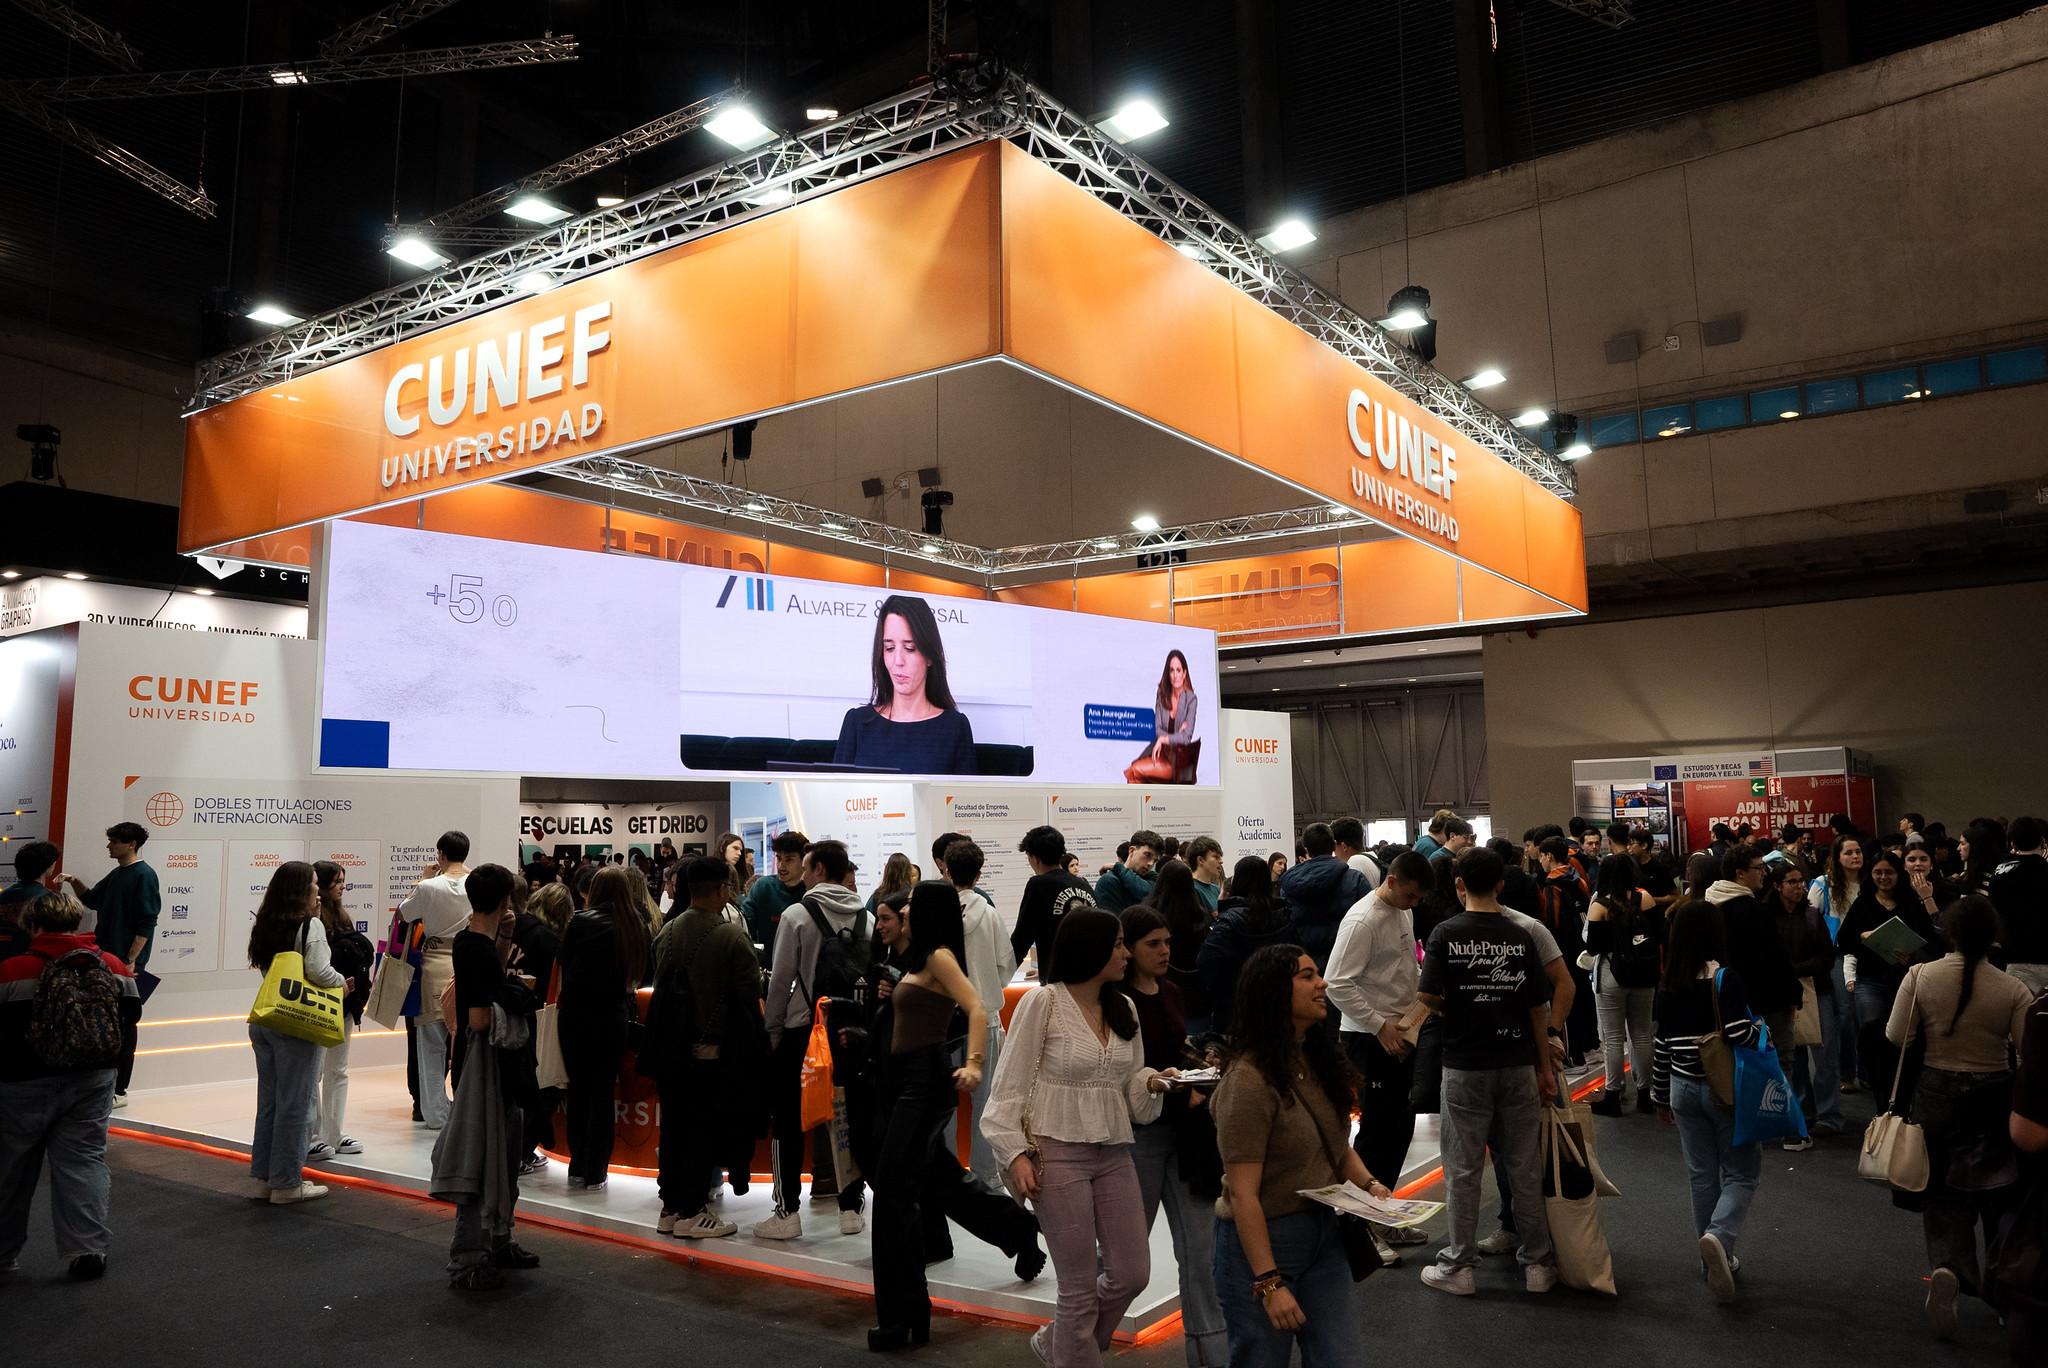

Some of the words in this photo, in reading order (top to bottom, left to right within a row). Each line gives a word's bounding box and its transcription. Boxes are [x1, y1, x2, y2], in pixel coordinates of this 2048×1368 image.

[384, 301, 612, 437] CUNEF
[381, 402, 604, 488] UNIVERSIDAD
[1347, 388, 1457, 501] CUNEF
[1351, 466, 1460, 542] UNIVERSIDAD
[128, 675, 258, 706] CUNEF
[129, 706, 255, 723] UNIVERSIDAD
[1234, 738, 1279, 754] CUNEF
[1236, 756, 1279, 764] UNIVERSIDAD
[1684, 764, 1714, 772] ESTUDIOS
[1692, 771, 1717, 779] EUROPA
[194, 798, 251, 810] DOBLES
[256, 798, 352, 811] TITULACIONES
[845, 797, 878, 812] CUNEF
[1805, 799, 1813, 812] Y
[193, 811, 323, 825] INTERNACIONALES
[520, 816, 613, 835] ESCUELAS
[628, 815, 657, 834] GET
[659, 814, 708, 834] DRIBO
[1237, 815, 1264, 827] Oferta
[1793, 813, 1839, 829] EE.U
[1238, 829, 1282, 840] Académica
[402, 845, 424, 854] grado
[390, 854, 422, 862] CUNEF
[400, 873, 422, 882] presti
[168, 886, 194, 894] IDRAC
[172, 904, 188, 912] ICN
[276, 1003, 310, 1018] UNIVERSIDAD
